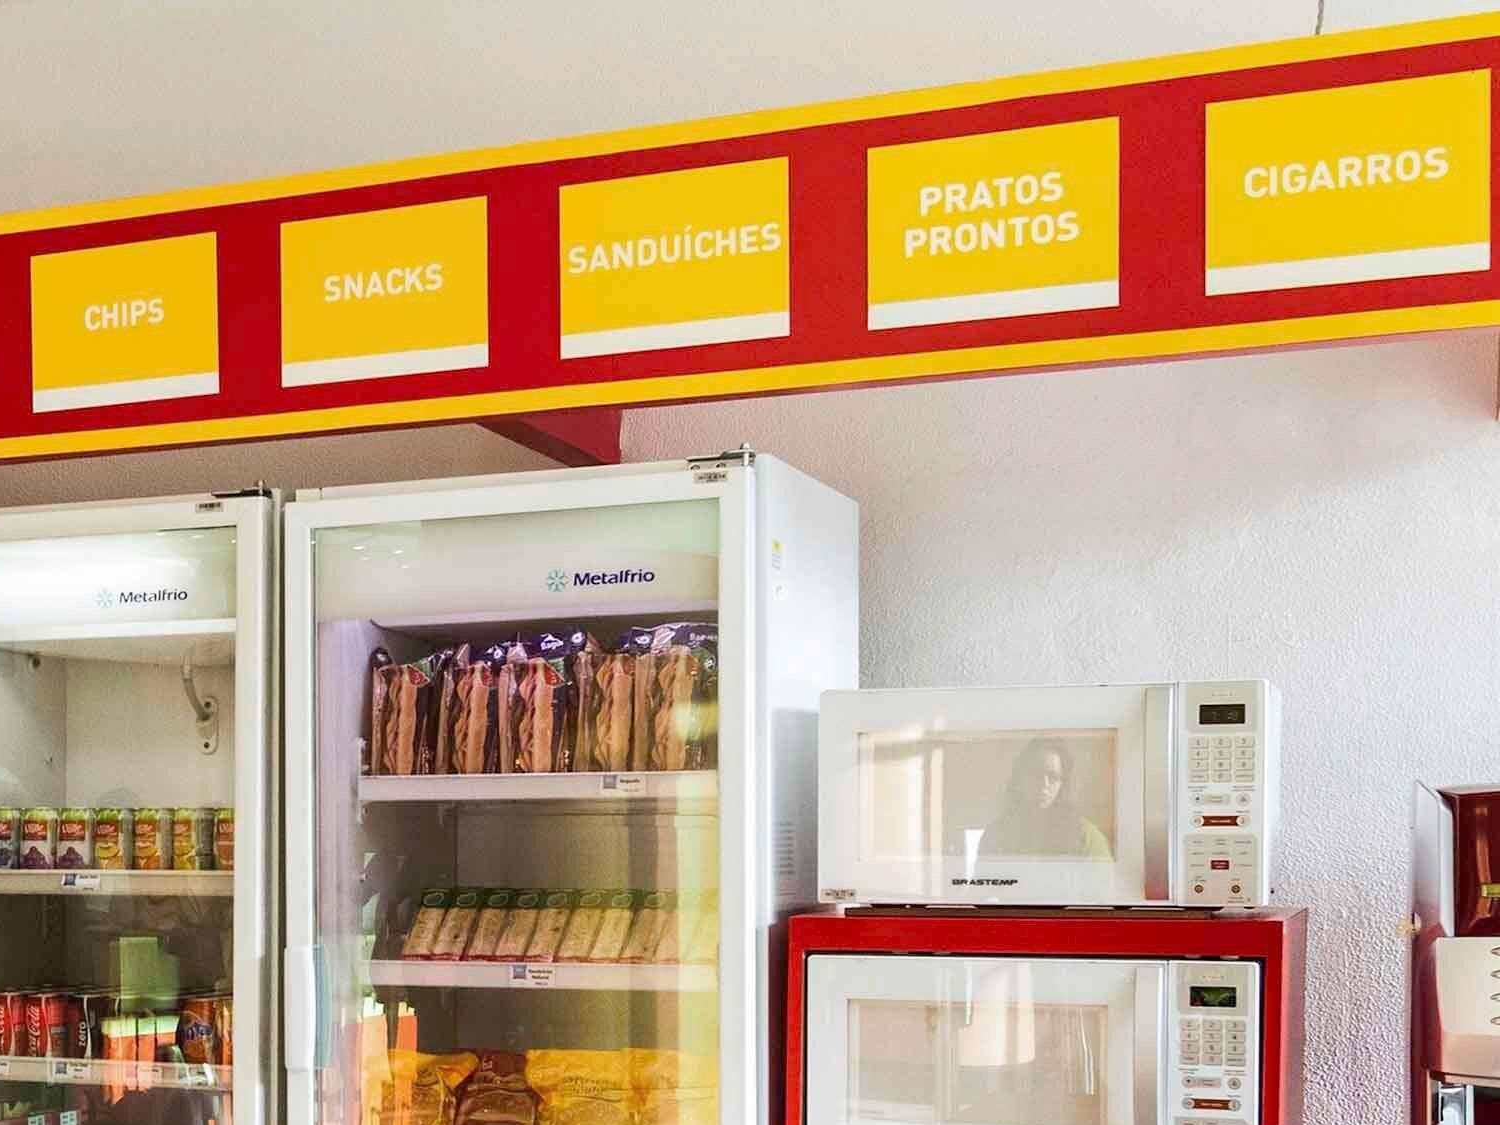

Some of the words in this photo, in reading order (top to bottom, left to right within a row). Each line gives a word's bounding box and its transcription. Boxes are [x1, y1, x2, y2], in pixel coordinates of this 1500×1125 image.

[918, 171, 1064, 217] PRATOS
[1243, 146, 1449, 199] CIGARROS
[567, 222, 781, 275] SANDUÍCHES
[903, 210, 1080, 258] PRONTOS
[323, 262, 444, 303] SNACKS
[84, 298, 165, 332] CHIPS
[118, 587, 189, 604] Metalfrio
[572, 568, 656, 587] Metalfrio
